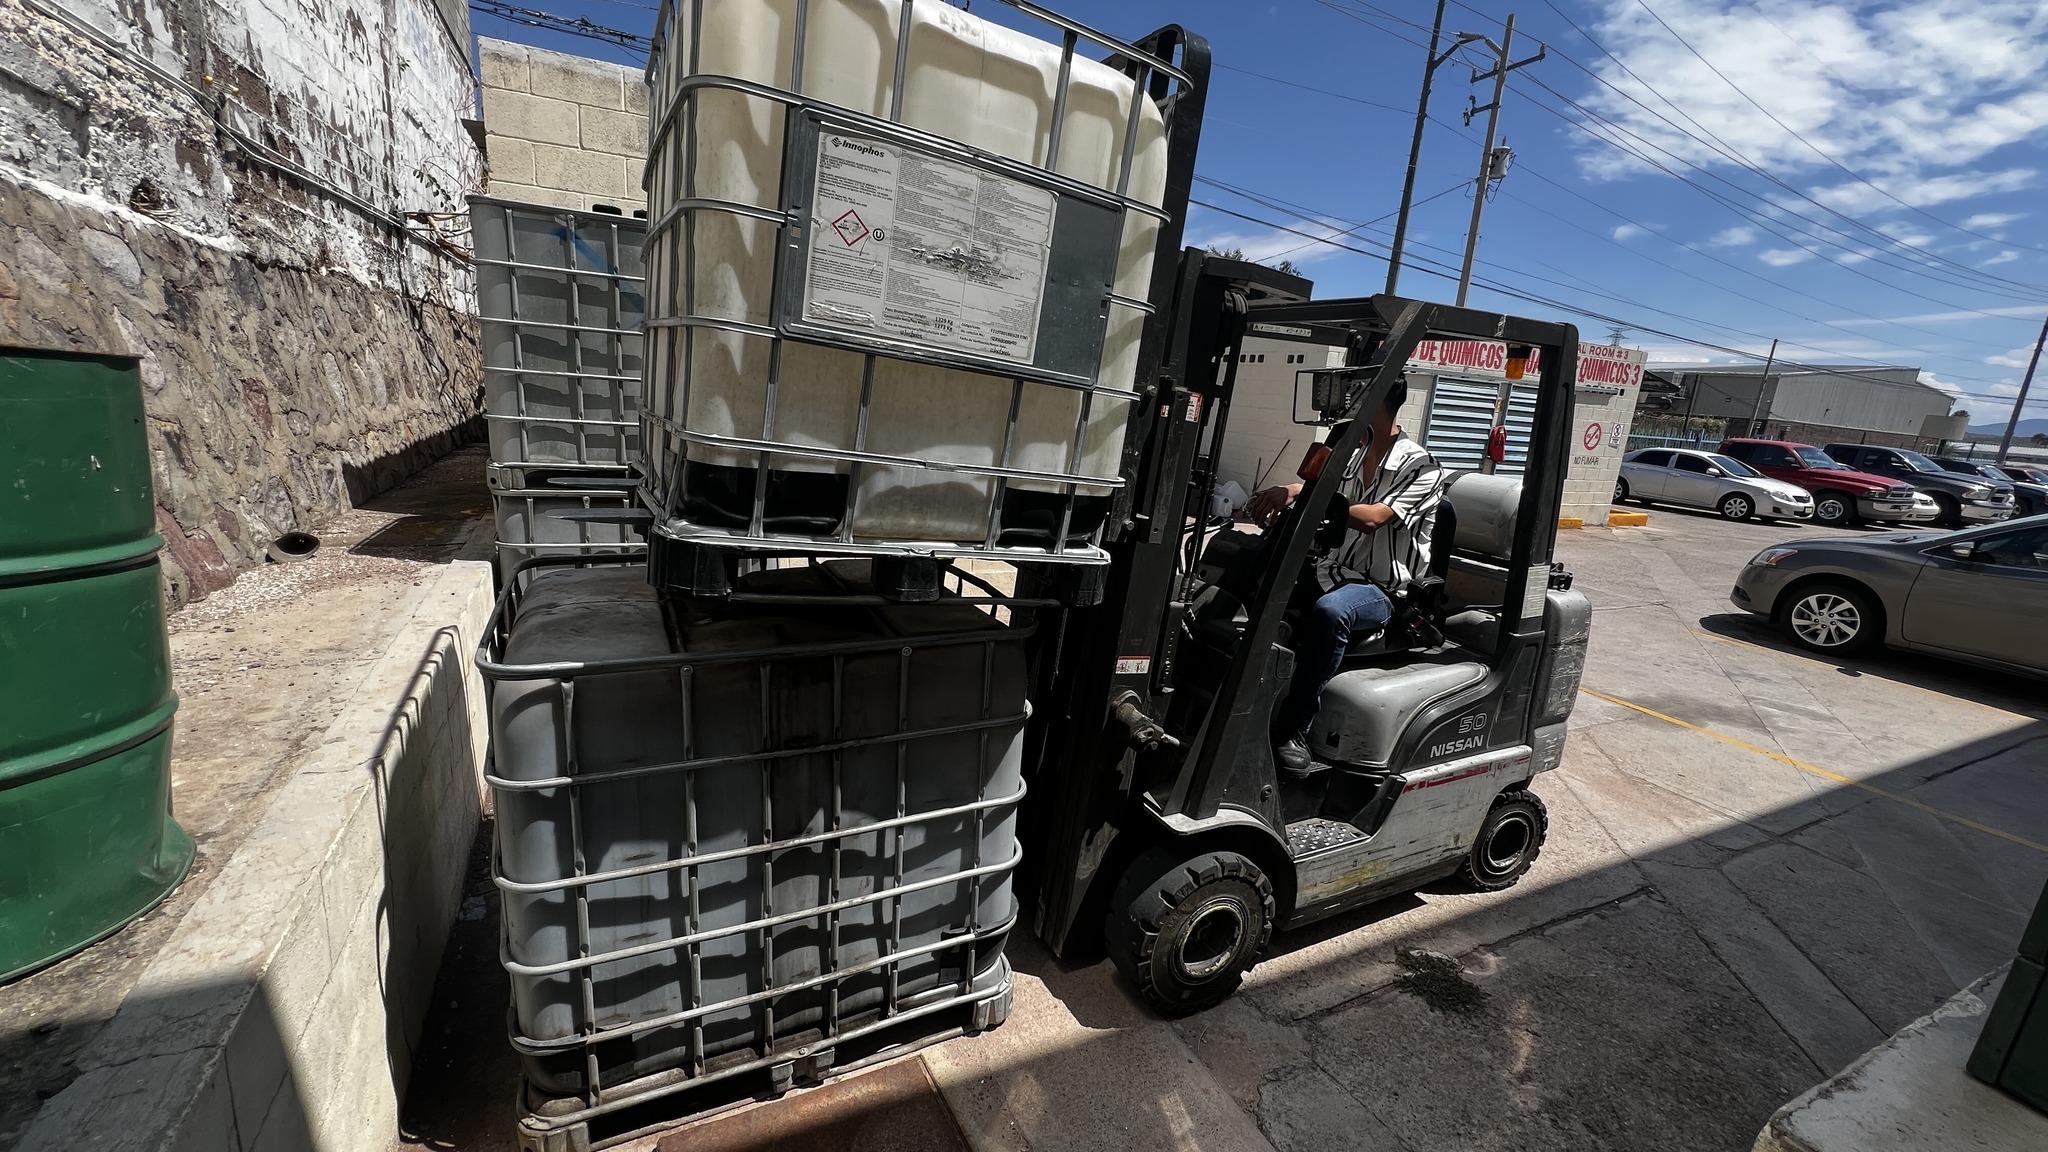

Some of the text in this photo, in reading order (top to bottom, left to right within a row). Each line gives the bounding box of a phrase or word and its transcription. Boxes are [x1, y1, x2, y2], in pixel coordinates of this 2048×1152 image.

[842, 139, 885, 158] Innophos
[1420, 341, 1437, 361] DE
[1438, 341, 1504, 369] QUIMICOS
[1589, 346, 1616, 357] ROOM
[1617, 350, 1629, 359] #3
[1578, 357, 1640, 385] QUIMICOS 3
[1573, 456, 1600, 466] NO FUMAR
[1458, 713, 1487, 734] 50
[1430, 734, 1484, 758] NISSAN
